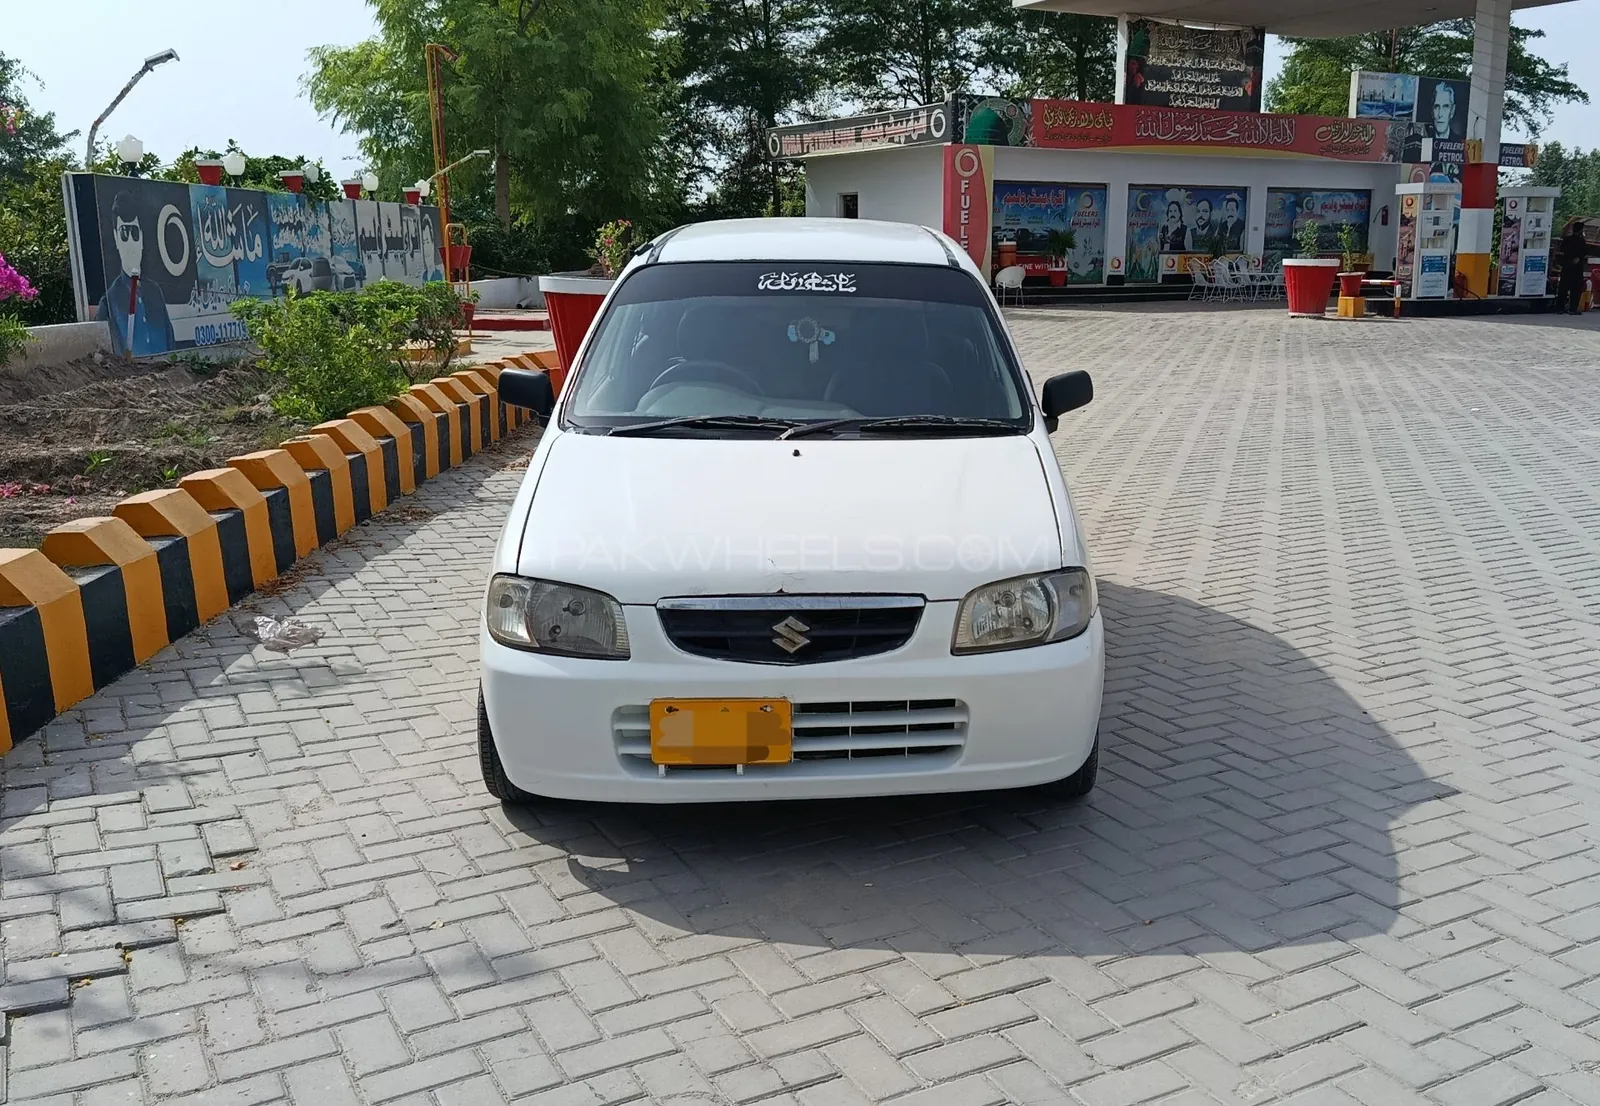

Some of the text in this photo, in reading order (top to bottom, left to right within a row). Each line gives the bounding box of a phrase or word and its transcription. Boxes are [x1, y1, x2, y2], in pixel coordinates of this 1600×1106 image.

[1439, 142, 1464, 150] FUELERS
[1502, 146, 1524, 154] FUELERS
[1438, 152, 1464, 162] PETROL
[1501, 155, 1524, 165] PETROL
